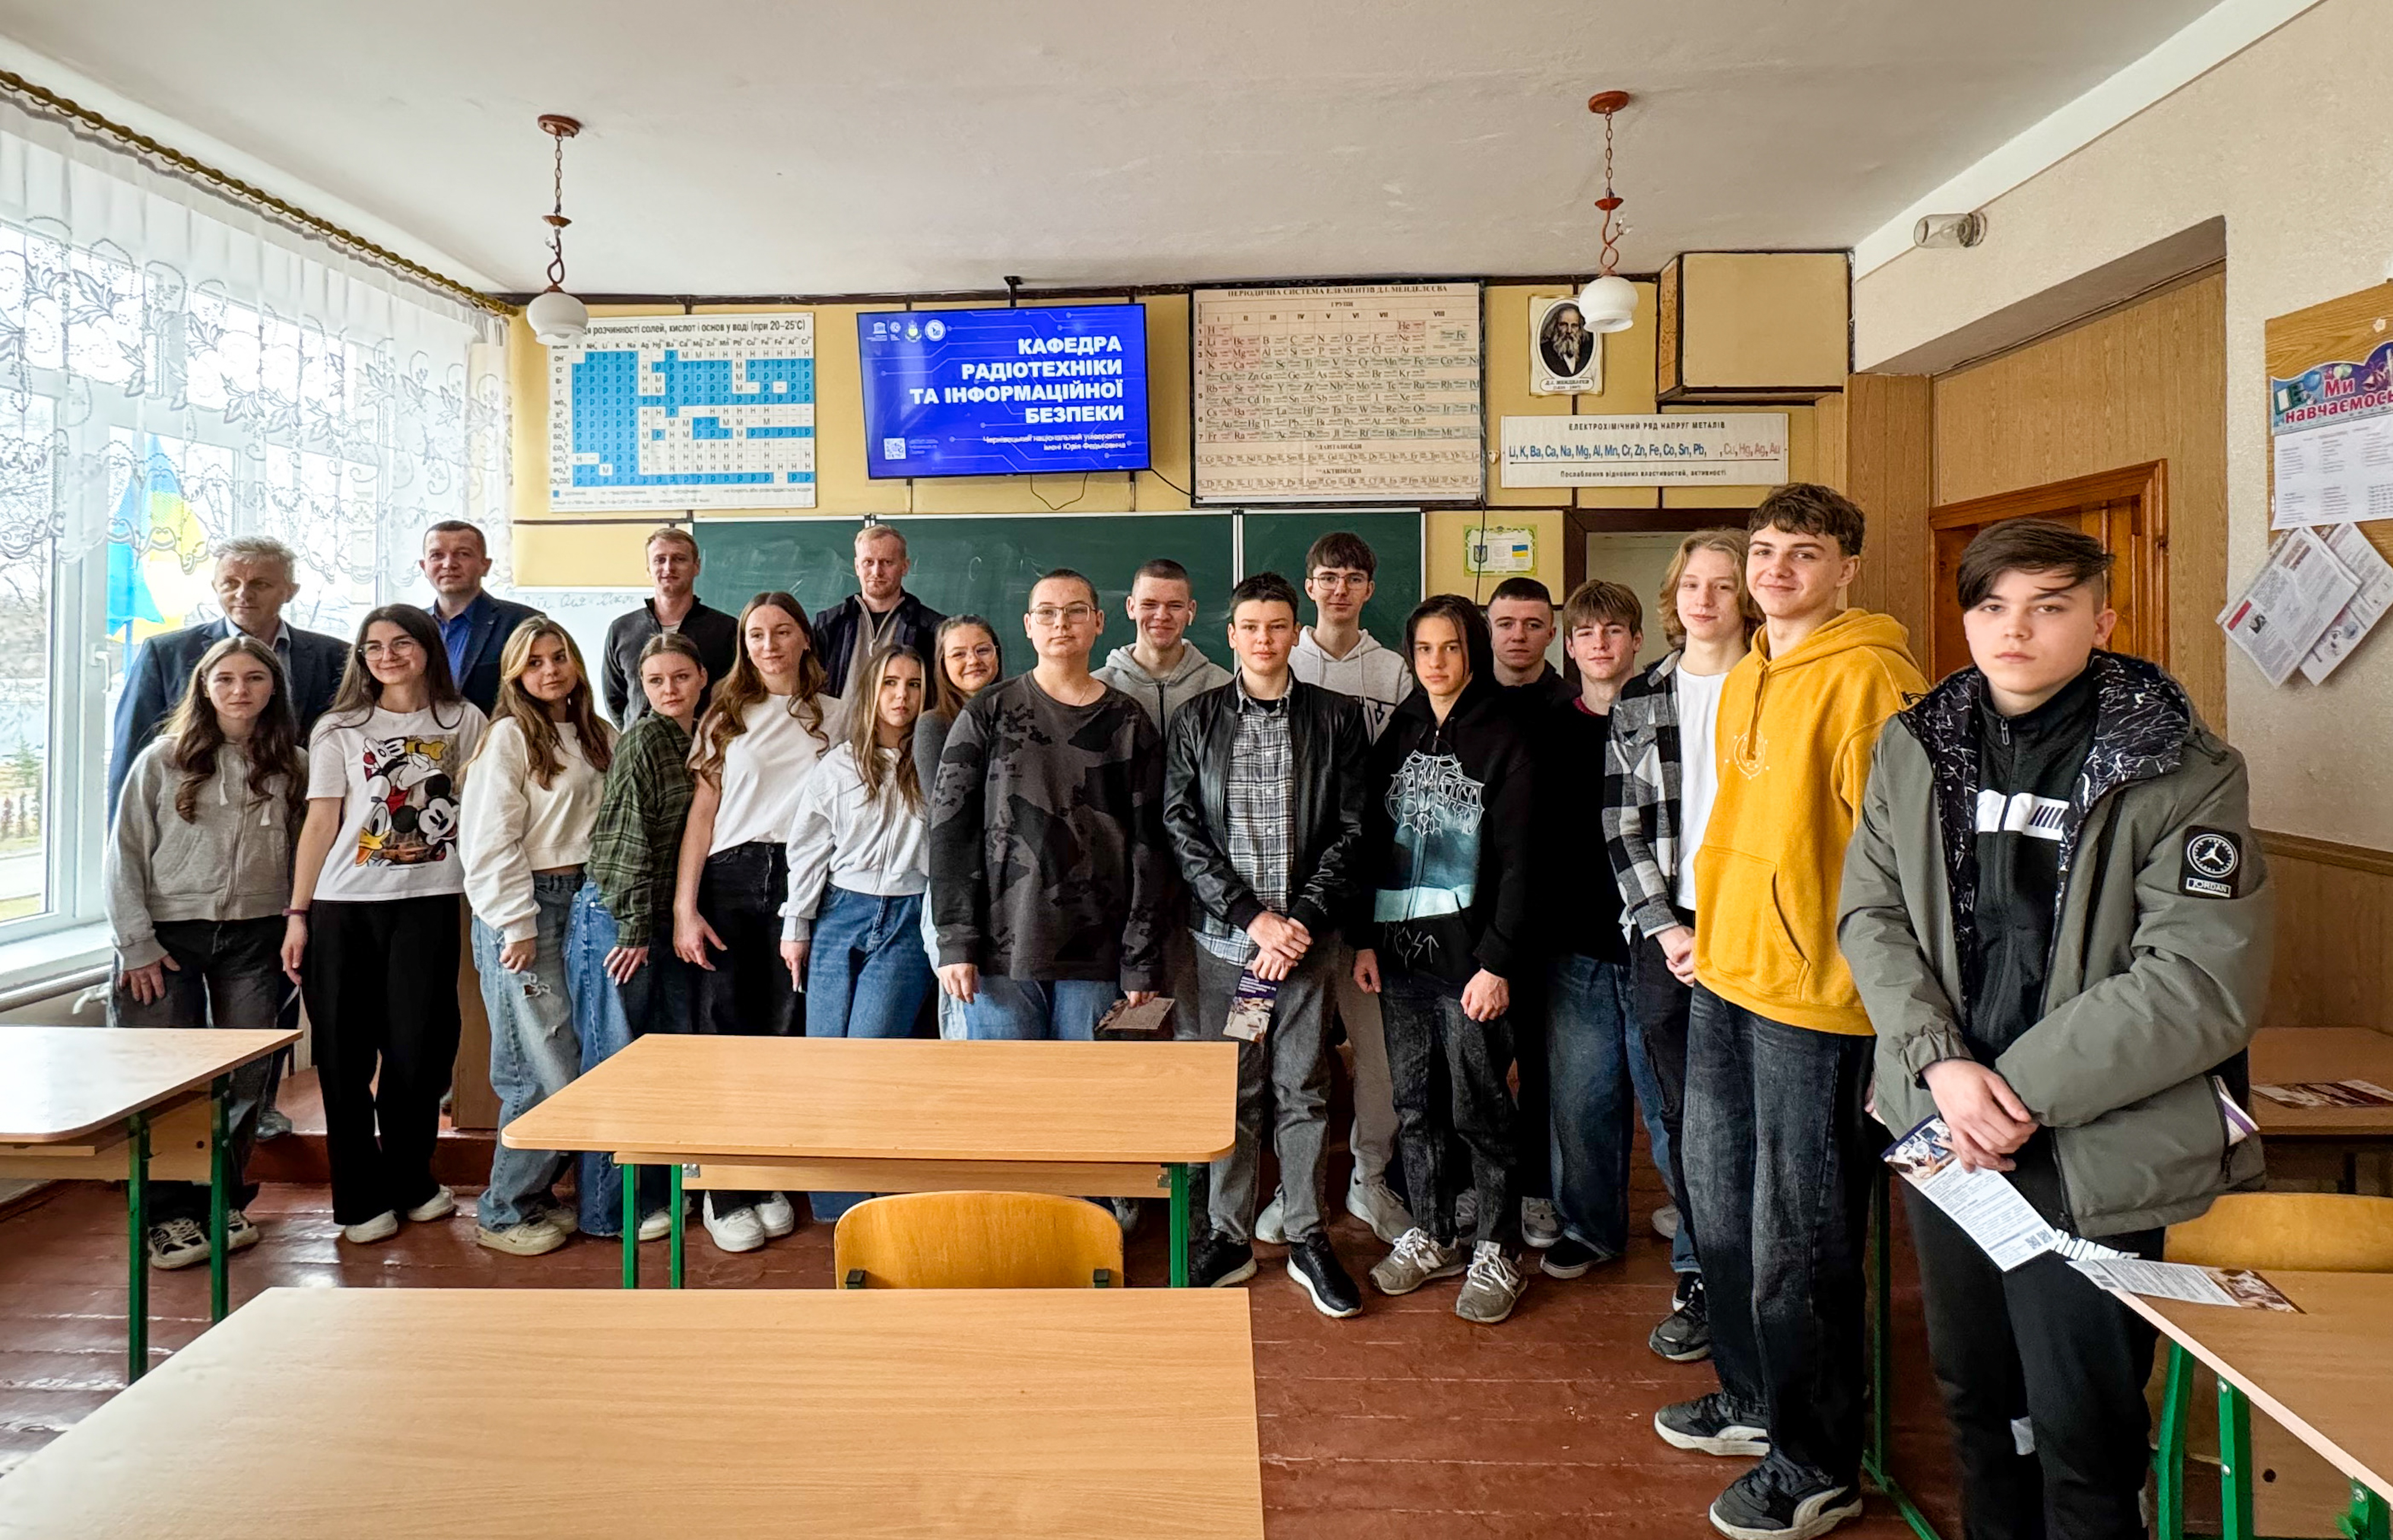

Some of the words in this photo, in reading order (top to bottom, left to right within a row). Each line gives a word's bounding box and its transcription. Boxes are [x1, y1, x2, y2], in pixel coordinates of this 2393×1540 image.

[594, 323, 639, 336] розчинності
[642, 323, 667, 334] солей,
[669, 325, 695, 333] кислот
[697, 322, 700, 332] і
[702, 323, 725, 332] основ
[726, 324, 731, 333] у
[732, 321, 749, 332] воді
[751, 320, 768, 333] (при
[1018, 335, 1122, 355] КАФЕДРА
[1318, 335, 1325, 343] N
[1345, 334, 1353, 342] O
[961, 359, 1122, 382] РАДІОТЕХНІКИ
[909, 389, 940, 405] ТА
[945, 380, 1123, 404] ІНФОРМАЦІЙНОЇ
[2324, 377, 2354, 398] Ми
[1025, 405, 1124, 424] БЕЗПЕКИ
[1248, 420, 1260, 429] Hg
[1569, 422, 1640, 430] ЕЛЕКТРОХІМІЧНИЙ
[1643, 422, 1658, 430] РЯД
[1520, 446, 1528, 459] K,
[1530, 445, 1543, 459] Ba,
[1545, 445, 1559, 459] Ca,
[1560, 445, 1574, 459] Na,
[1576, 445, 1591, 459] Mg,
[1604, 444, 1620, 458] Mn,
[1621, 444, 1633, 458] Cr,
[1635, 444, 1647, 458] Zn,
[1649, 444, 1662, 458] Fe,
[1663, 443, 1677, 458] Co,
[1678, 443, 1691, 458] Sn,
[1693, 443, 1706, 457] Pb,
[1770, 442, 1780, 454] Au
